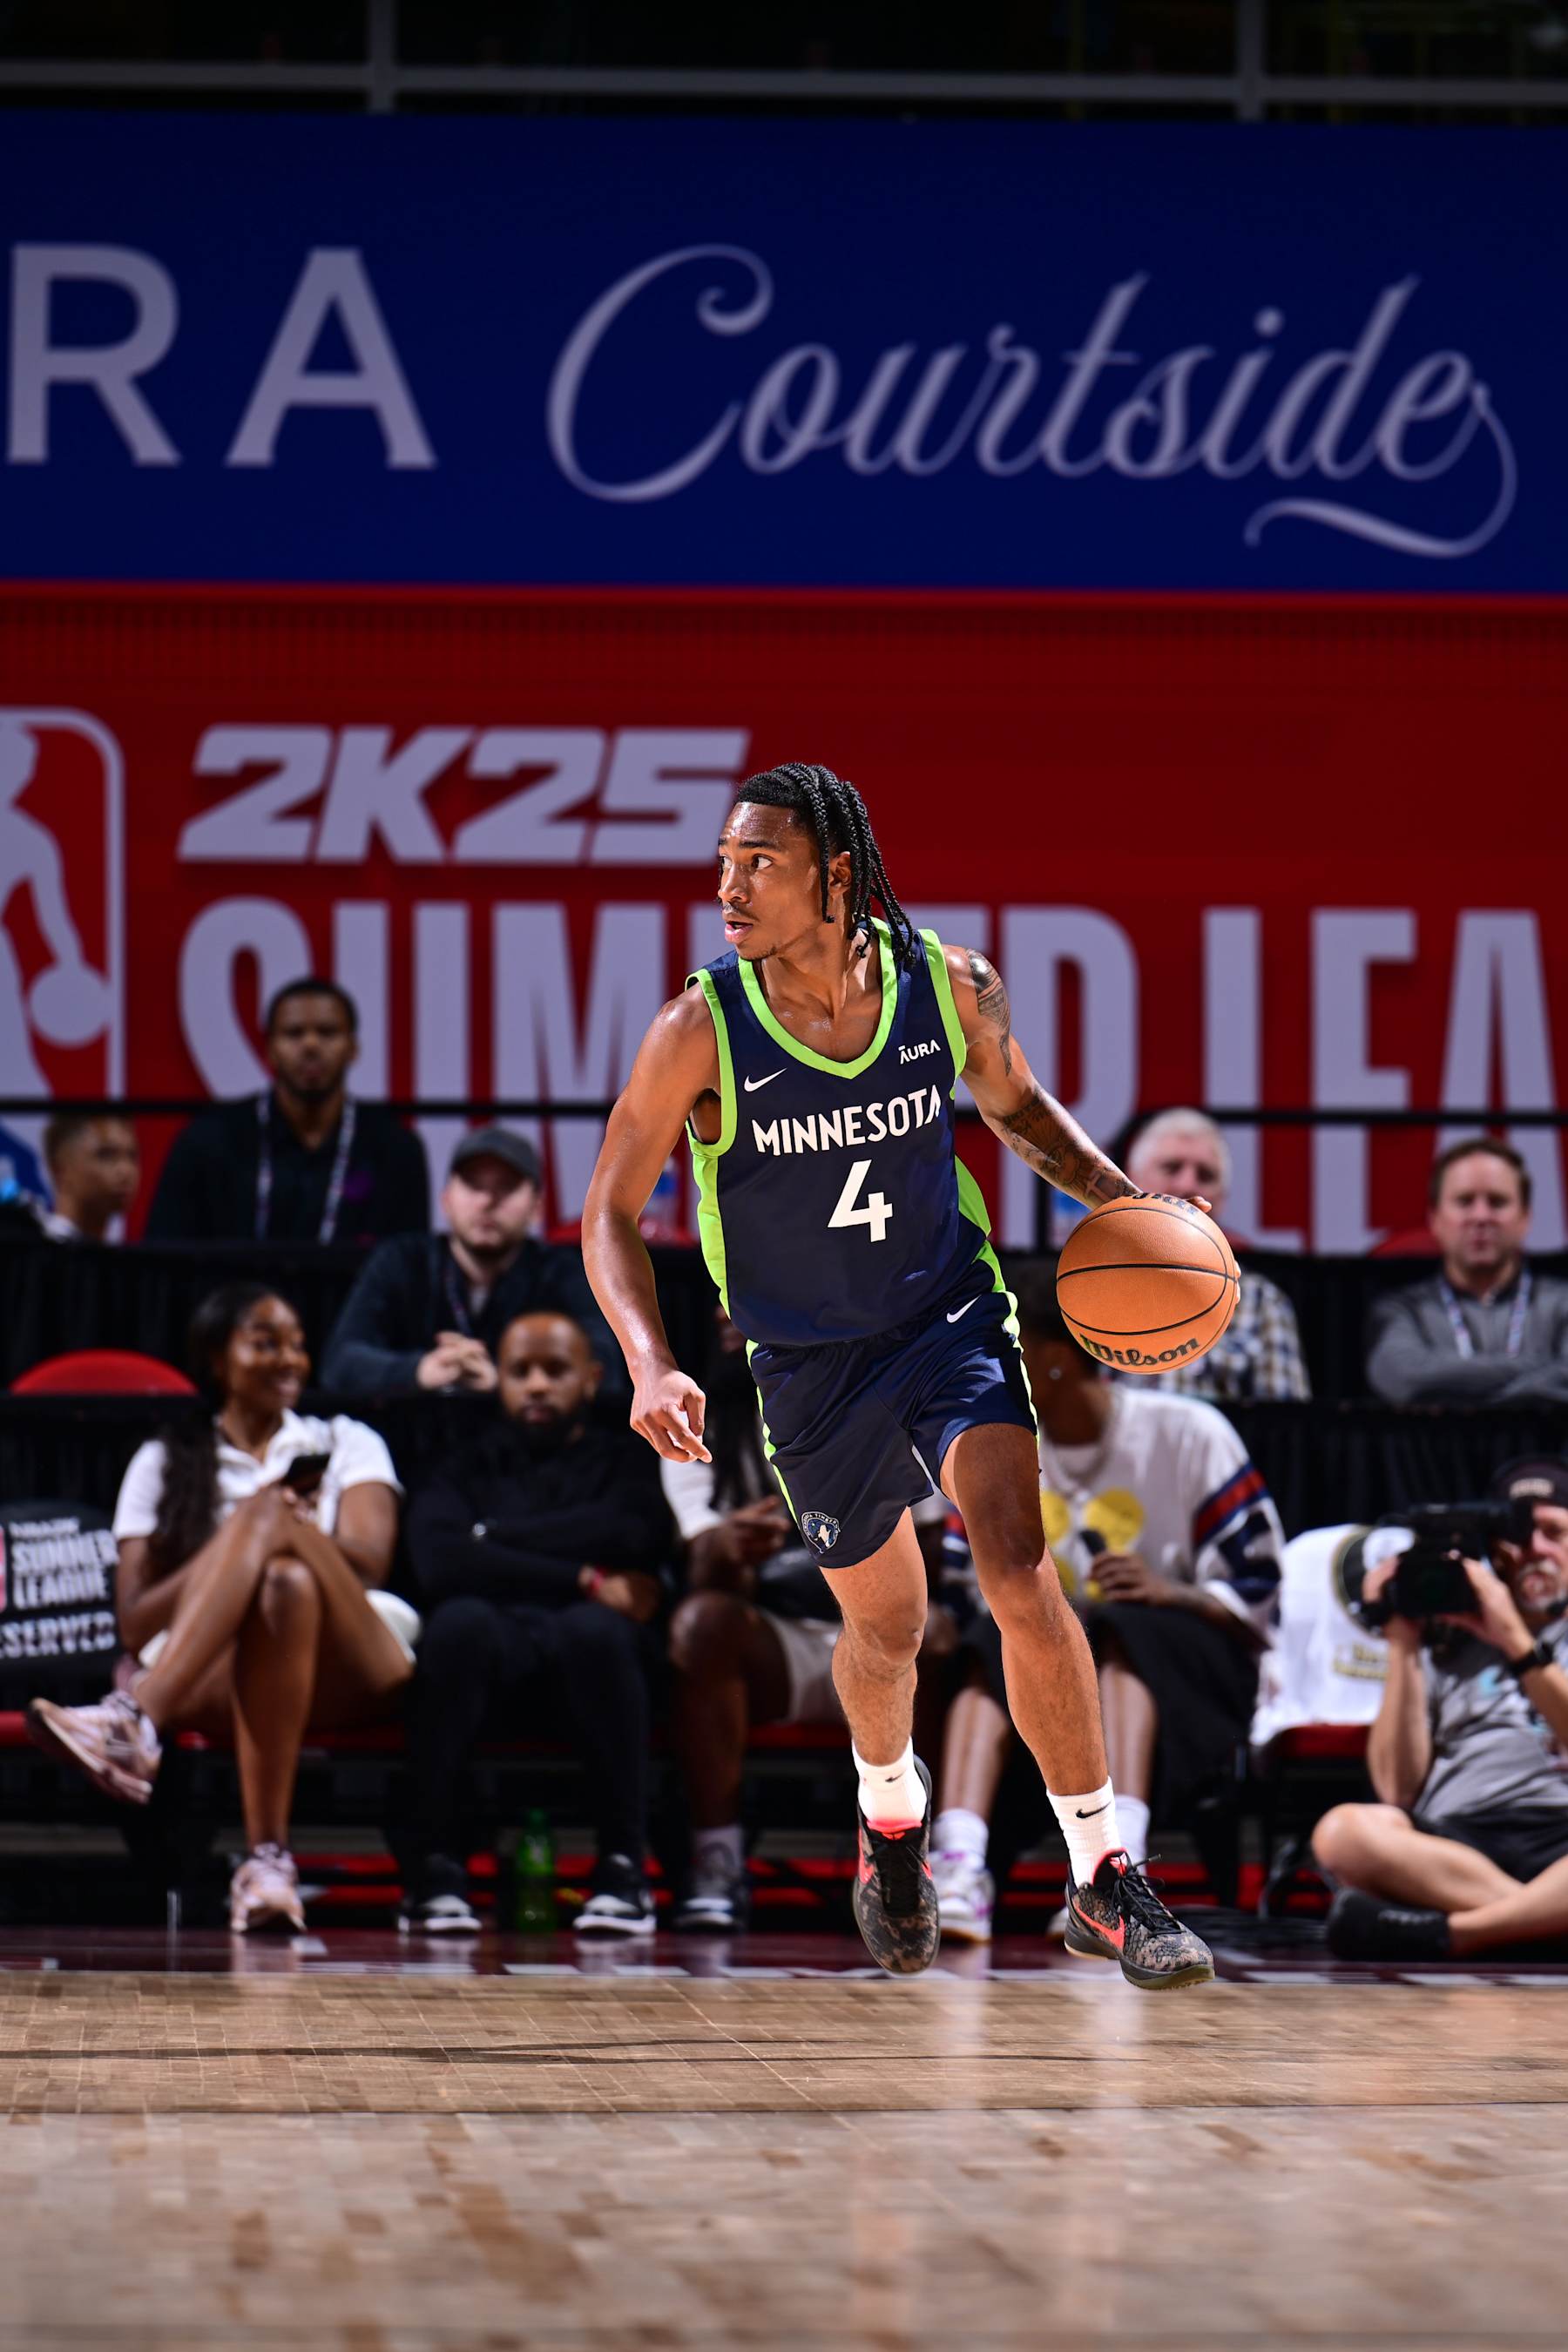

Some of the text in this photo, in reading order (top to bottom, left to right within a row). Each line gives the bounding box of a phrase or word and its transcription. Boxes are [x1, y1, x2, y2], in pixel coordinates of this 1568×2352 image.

[546, 243, 1517, 559] Courtside
[179, 725, 751, 863] 2K25
[752, 1085, 942, 1156] MINNESOTA
[828, 1159, 893, 1242] 4
[1079, 1332, 1199, 1366] Wilson
